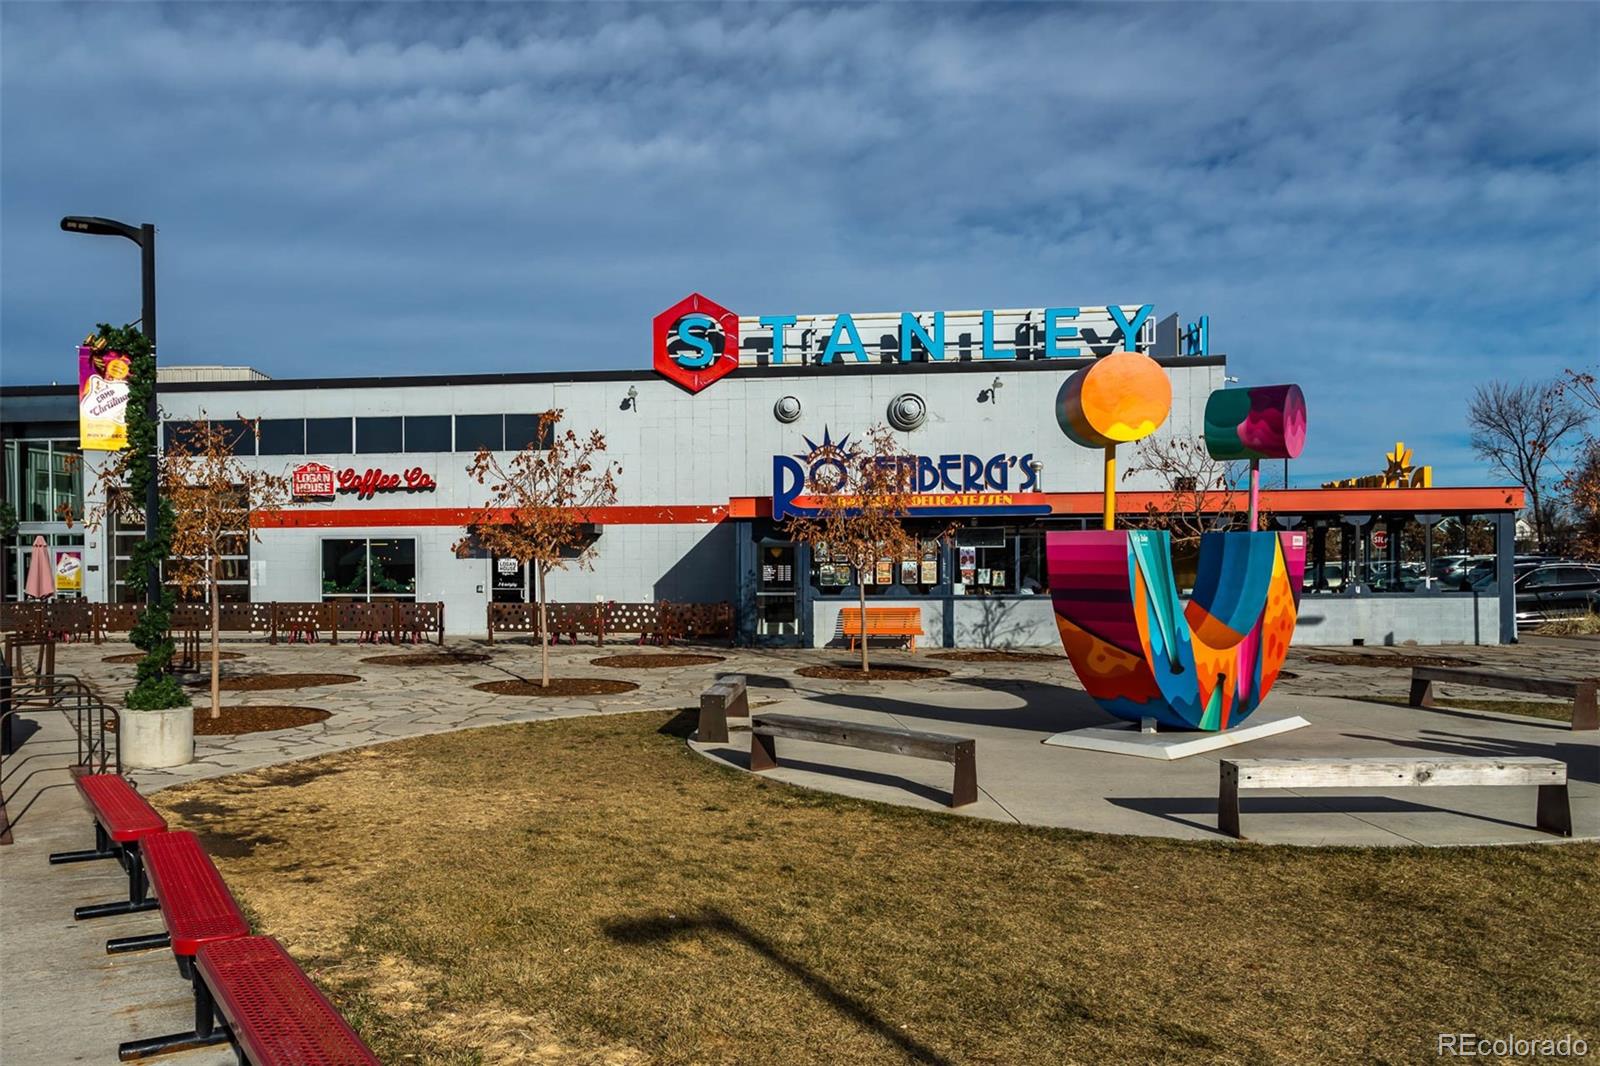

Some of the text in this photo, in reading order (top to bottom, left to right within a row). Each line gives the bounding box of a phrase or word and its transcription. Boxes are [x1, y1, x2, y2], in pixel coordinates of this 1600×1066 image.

[677, 304, 1155, 367] STANLEY
[96, 389, 115, 403] CAMP
[296, 473, 330, 483] LOGAN
[337, 467, 436, 499] Coffee Co.
[296, 483, 330, 492] HOUSE
[912, 494, 1013, 506] DELICATESSEN
